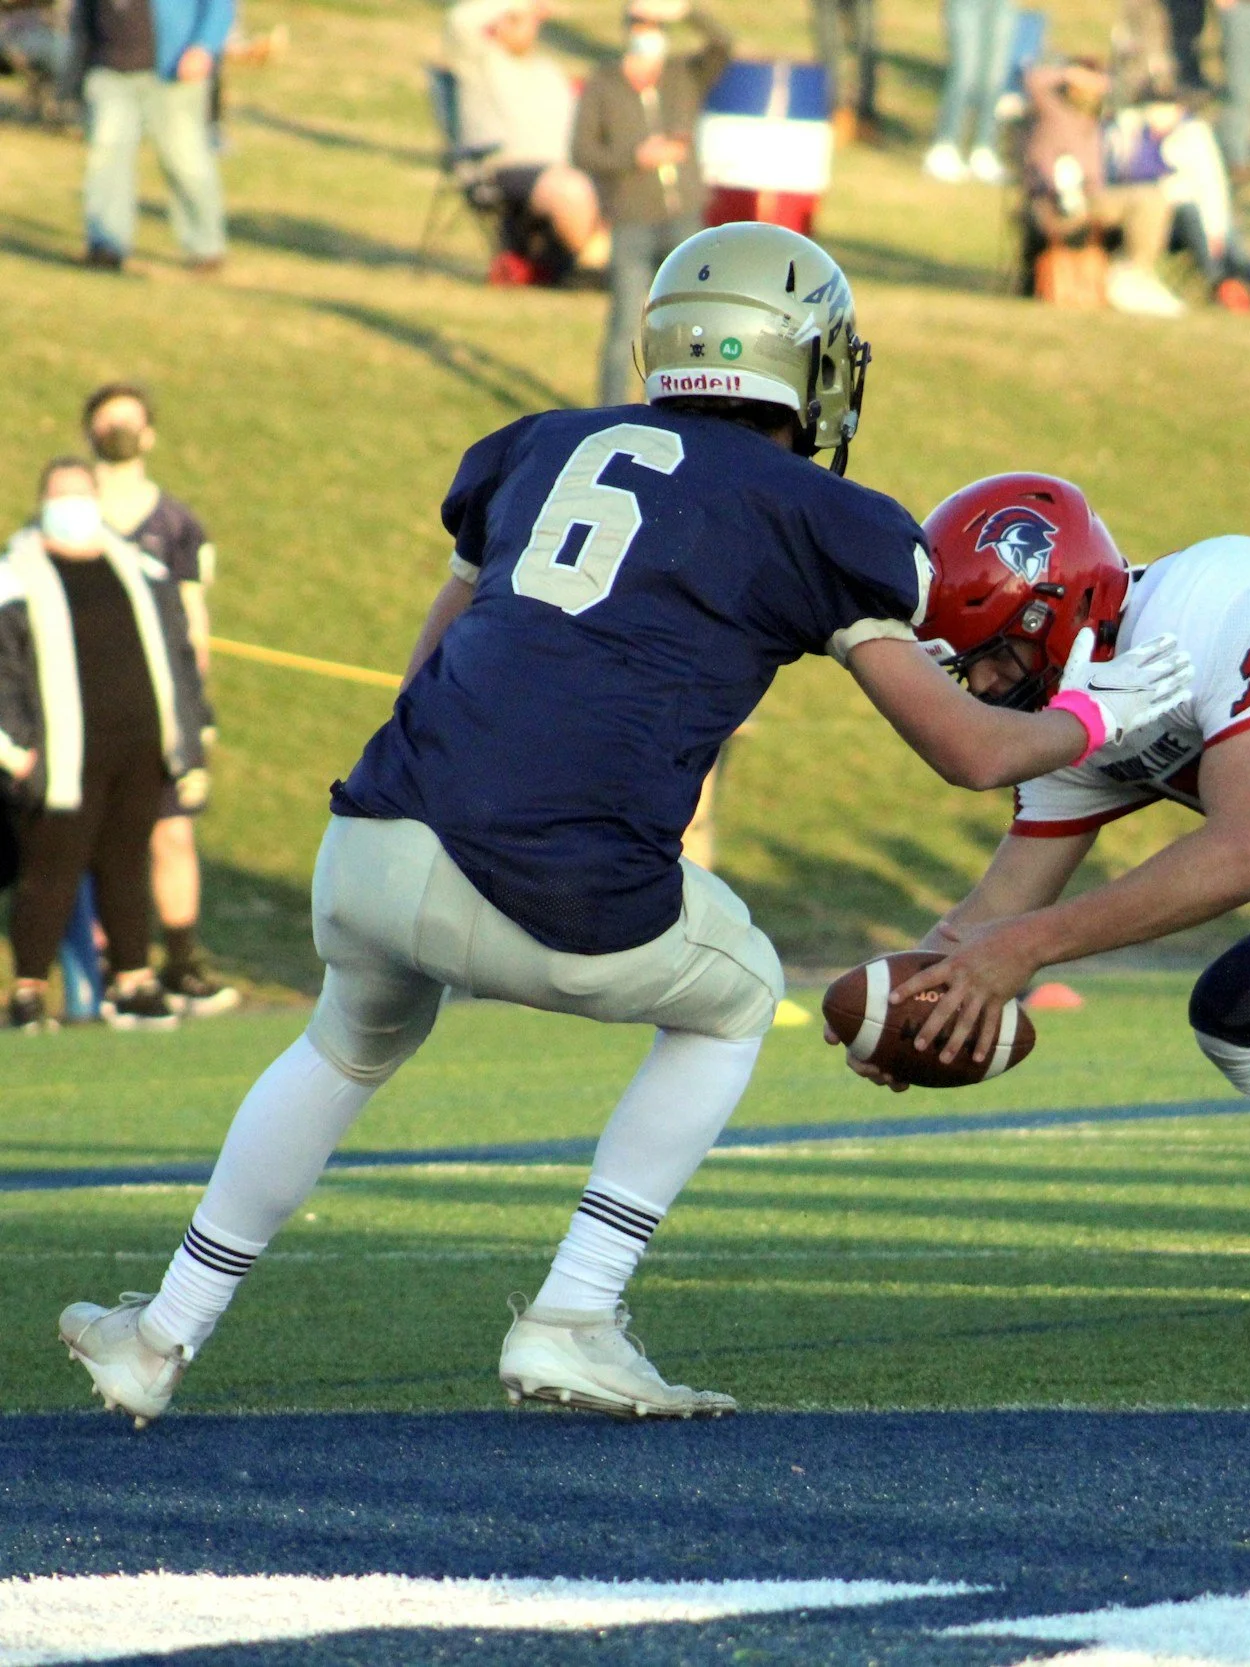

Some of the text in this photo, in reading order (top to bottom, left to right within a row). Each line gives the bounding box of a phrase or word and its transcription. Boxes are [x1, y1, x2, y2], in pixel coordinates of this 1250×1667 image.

[698, 264, 711, 281] 6
[722, 343, 739, 355] AJ
[511, 423, 685, 616] 6
